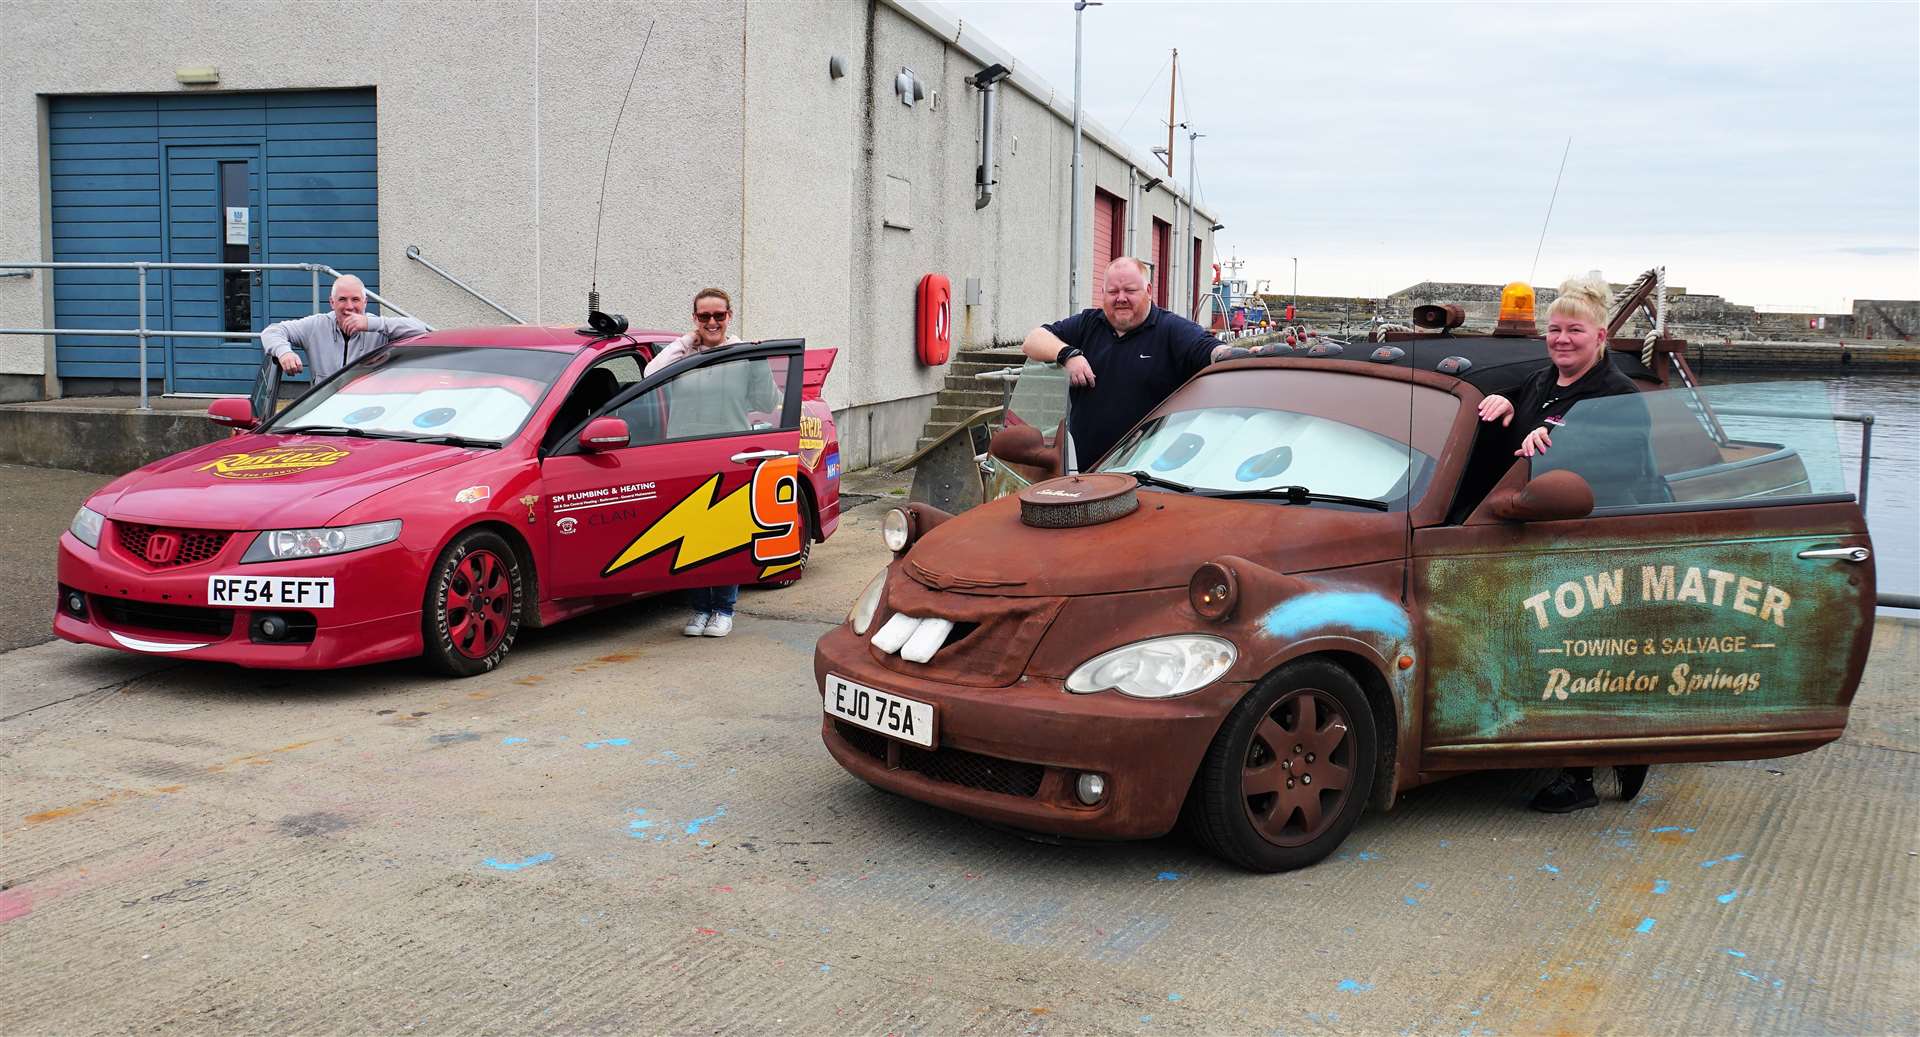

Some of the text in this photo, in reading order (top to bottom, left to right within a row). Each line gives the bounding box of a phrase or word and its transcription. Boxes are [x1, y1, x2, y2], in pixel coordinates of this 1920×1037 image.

[552, 481, 656, 503] SM PLUMBING & HEATING
[588, 508, 637, 527] CLAN
[750, 454, 800, 566] 9
[213, 579, 329, 604] RF54 EFT
[1522, 565, 1791, 630] TOW MATER
[1562, 636, 1746, 657] TOWING & SALVAGE
[1541, 663, 1761, 701] Radiator Springs
[875, 696, 914, 736] 75A
